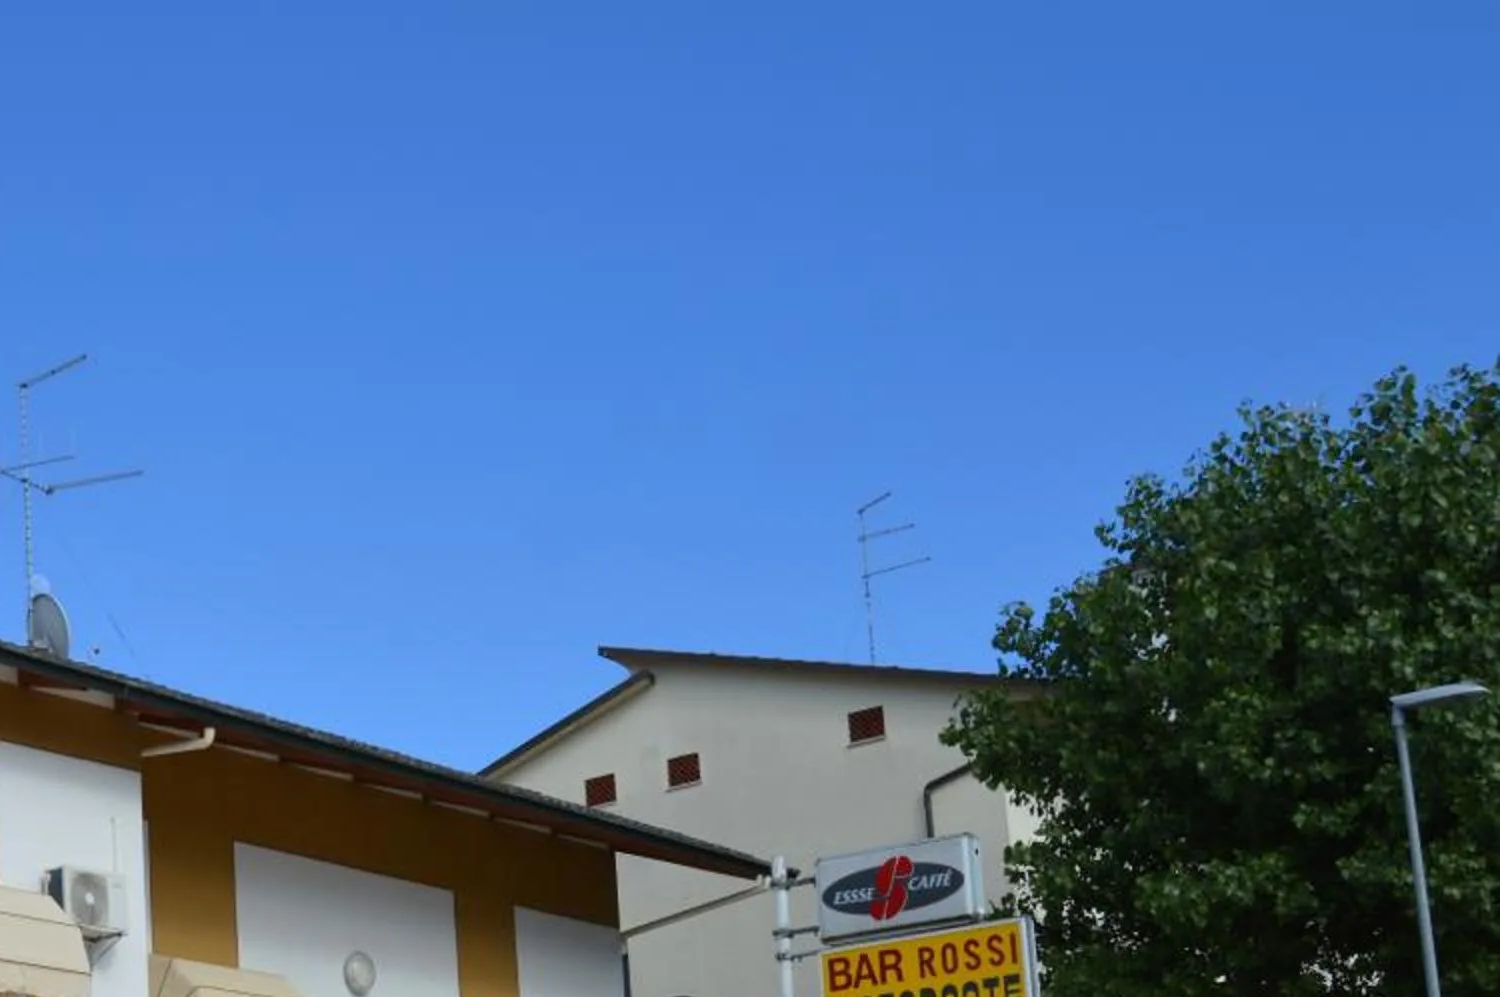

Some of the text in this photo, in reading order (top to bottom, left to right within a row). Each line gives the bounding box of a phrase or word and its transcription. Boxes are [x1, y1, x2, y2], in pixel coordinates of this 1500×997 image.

[833, 887, 876, 906] ESSSE
[828, 934, 1018, 991] BAR ROSSI
